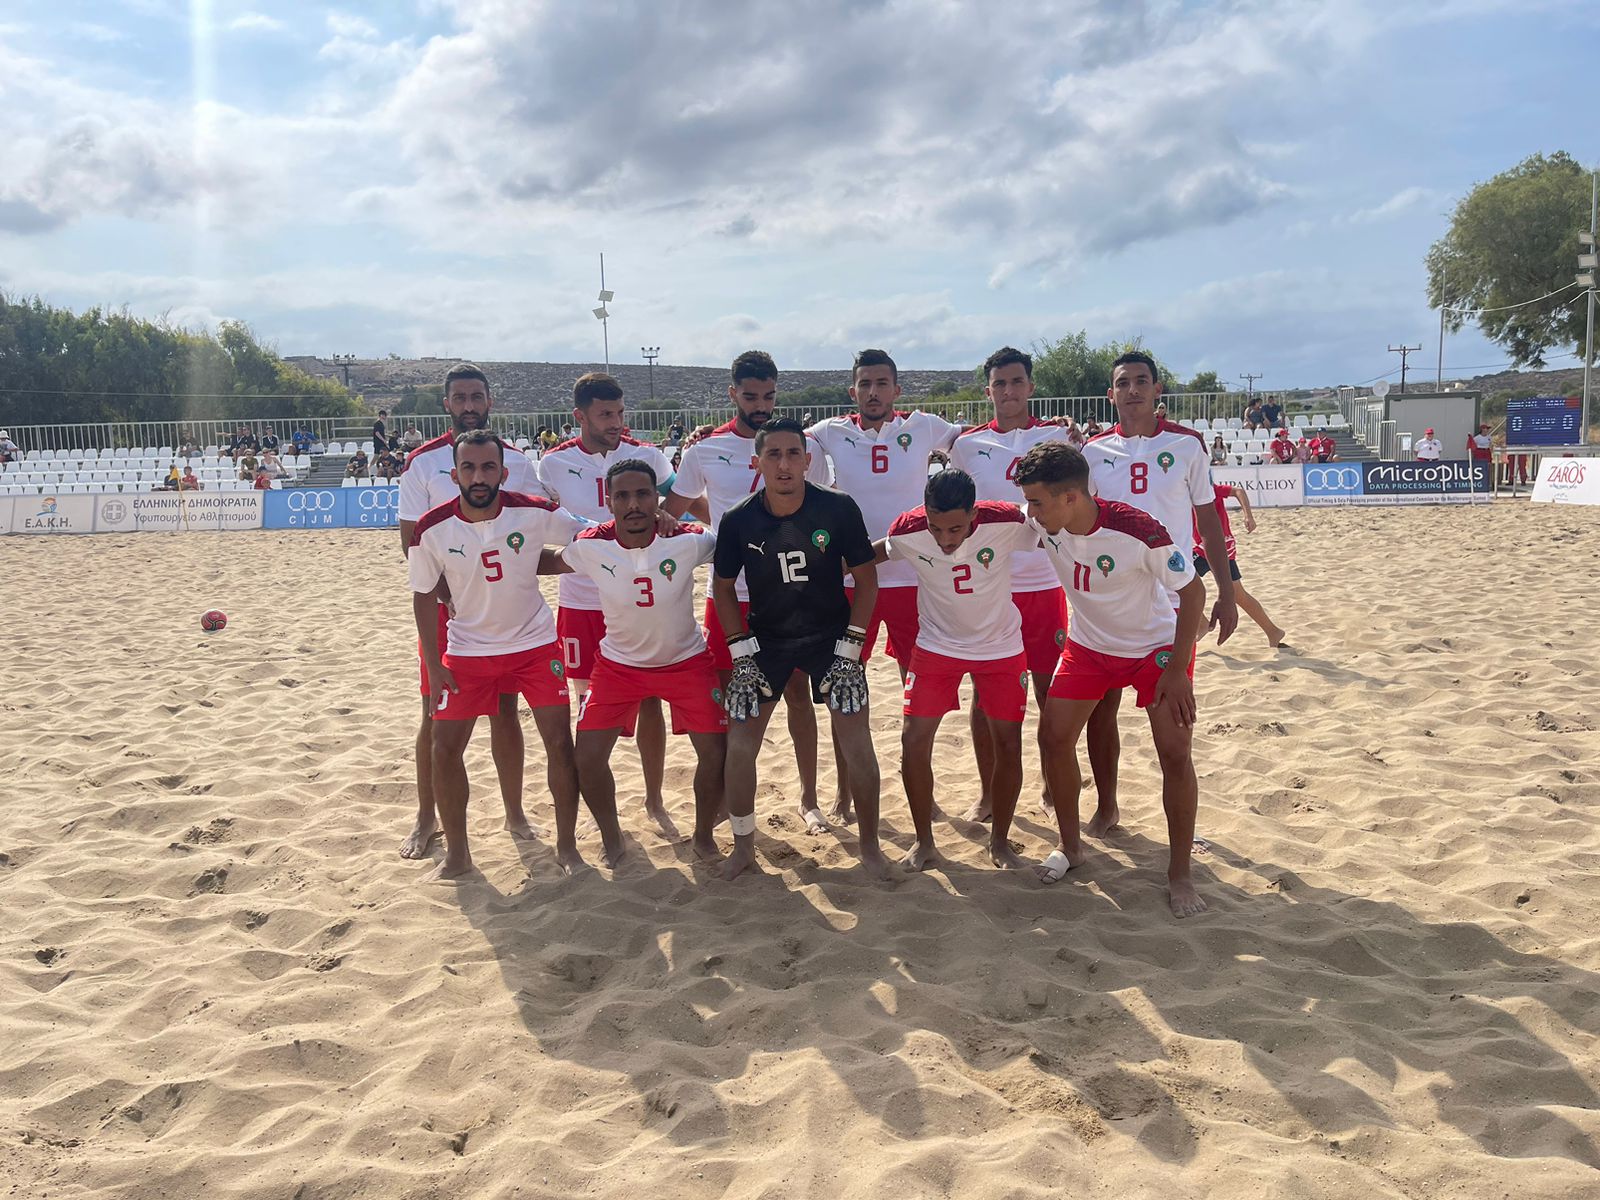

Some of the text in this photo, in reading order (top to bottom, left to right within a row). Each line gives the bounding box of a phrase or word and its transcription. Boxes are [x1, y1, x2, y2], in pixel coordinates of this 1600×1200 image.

[871, 445, 889, 473] 6
[1130, 462, 1148, 495] 8
[1454, 480, 1483, 488] TIMING
[480, 550, 503, 582] 5
[777, 550, 809, 583] 12
[952, 564, 973, 594] 2
[1073, 561, 1091, 592] 11
[633, 577, 654, 607] 3
